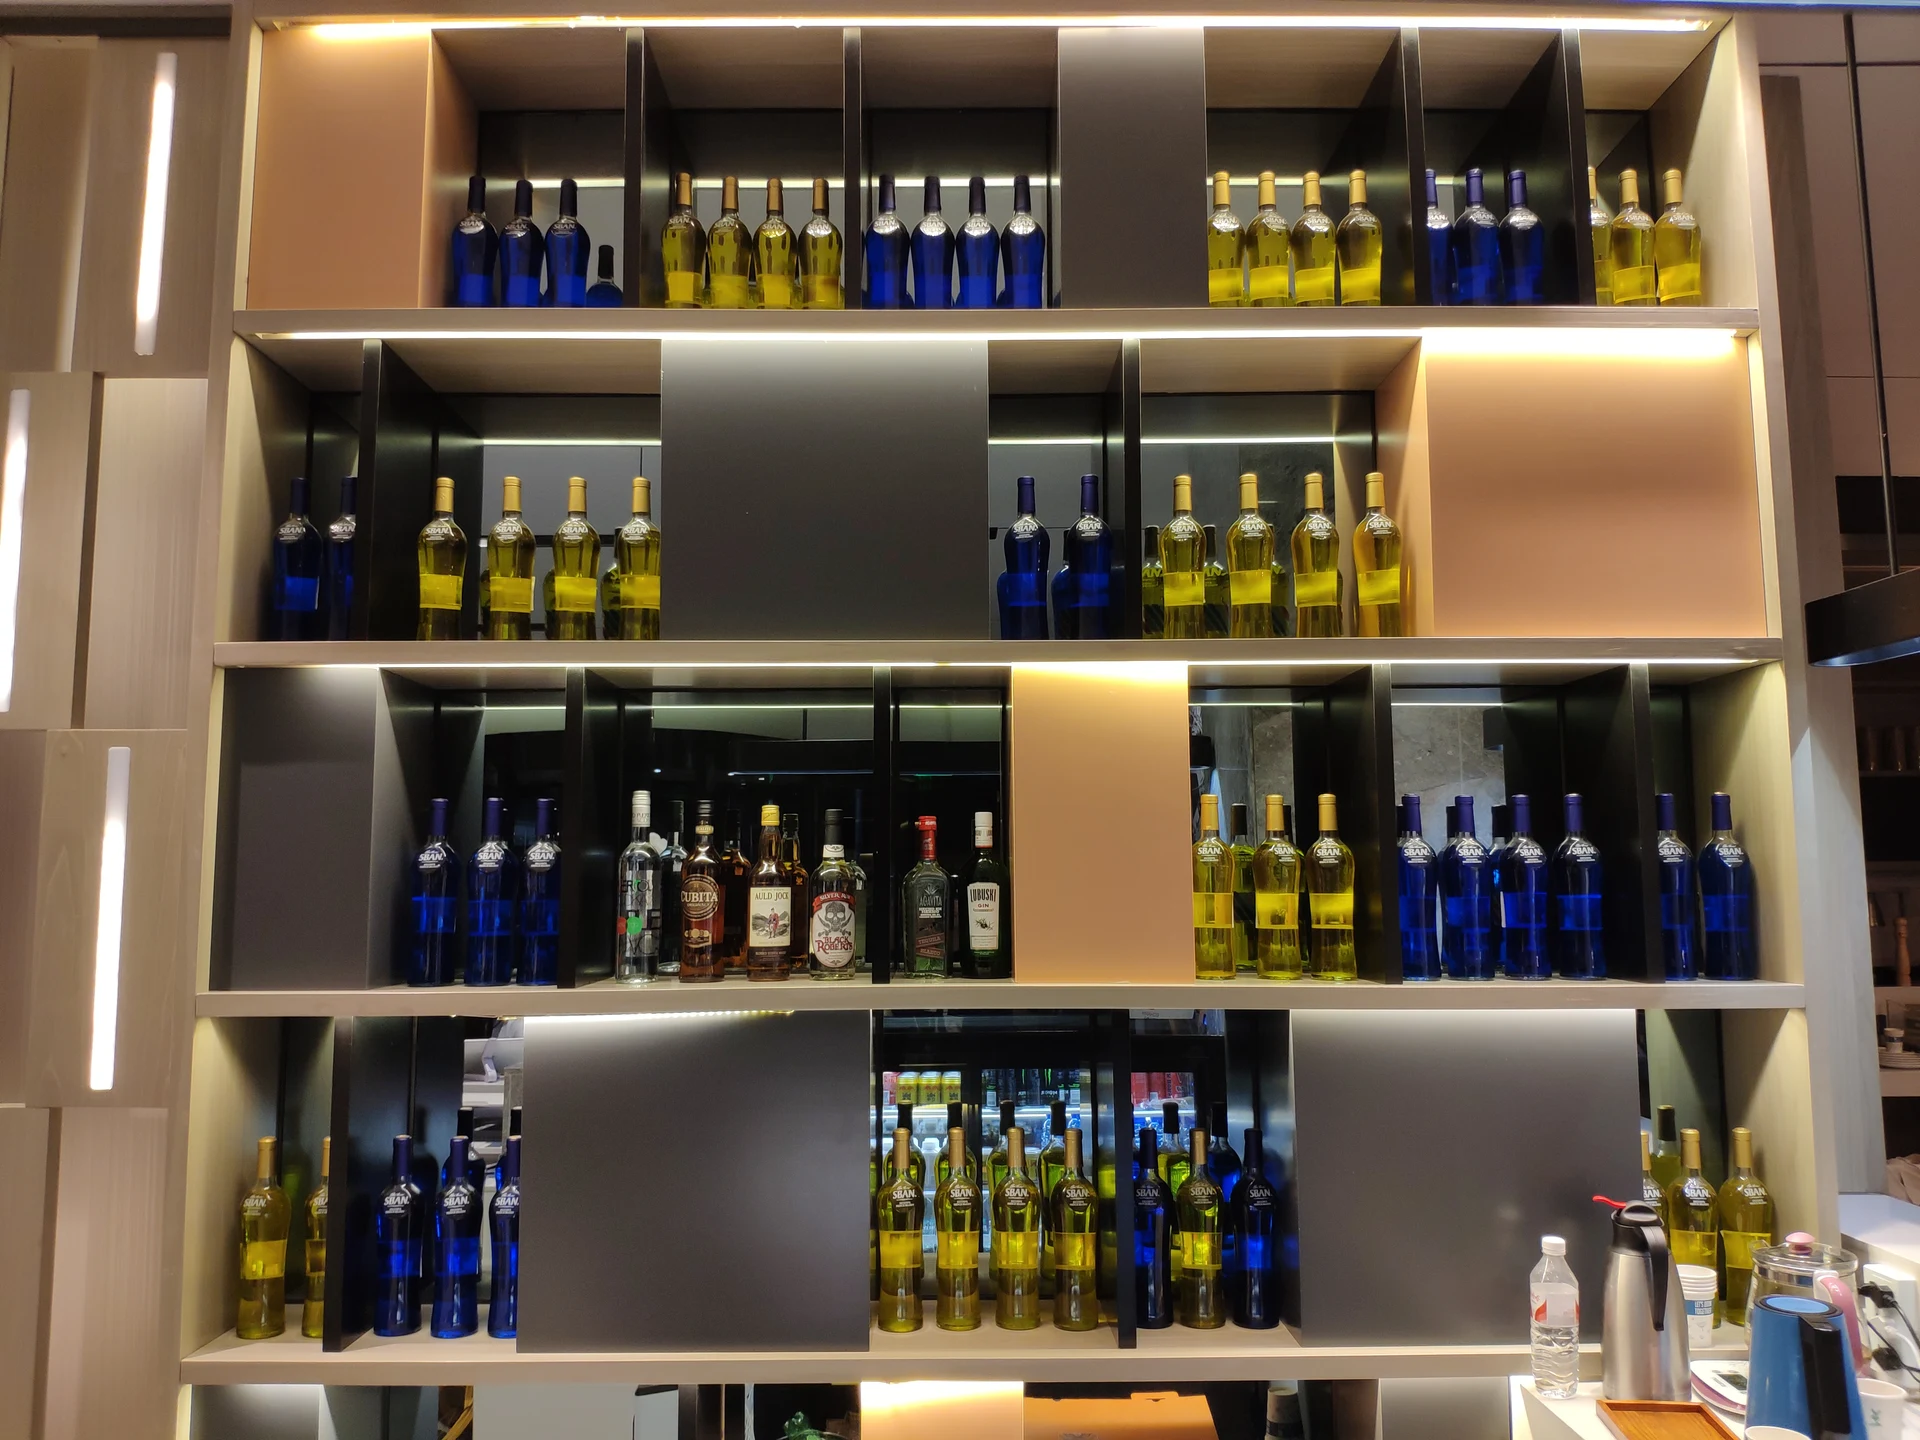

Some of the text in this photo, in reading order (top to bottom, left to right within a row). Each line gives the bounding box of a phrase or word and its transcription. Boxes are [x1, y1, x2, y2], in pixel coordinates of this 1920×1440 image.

[1198, 846, 1222, 855] SBAN
[1274, 847, 1296, 855] SBAN
[1317, 848, 1342, 856] SBAN
[1404, 848, 1429, 856] SBAN
[1458, 848, 1483, 856] SBAN
[1520, 848, 1543, 856] SBAN
[1572, 847, 1596, 855] SBAN
[1659, 847, 1684, 856] SBAN
[1718, 847, 1743, 855] SBAN
[419, 853, 444, 861] SBAN
[477, 852, 503, 860] SBAN
[529, 852, 554, 860] SBAN
[681, 891, 719, 903] CUBITA
[755, 891, 788, 901] AULD JOCK
[823, 936, 849, 945] BLACK
[815, 940, 852, 954] ROBERTS
[893, 1188, 917, 1199] SBAN
[950, 1188, 974, 1198] SBAN
[1005, 1188, 1029, 1198] SBAN
[1066, 1188, 1089, 1198] SBAN
[1136, 1188, 1160, 1197] SBAN
[1191, 1187, 1214, 1196] SBAN
[1249, 1188, 1273, 1198] SBAN
[1643, 1188, 1662, 1198] BAN
[1685, 1188, 1711, 1198] SBAN
[1744, 1187, 1768, 1197] SBAN
[244, 1198, 267, 1207] SBAN
[384, 1195, 409, 1206] SBAN
[443, 1195, 469, 1207] SBAN
[495, 1197, 520, 1206] SBAN
